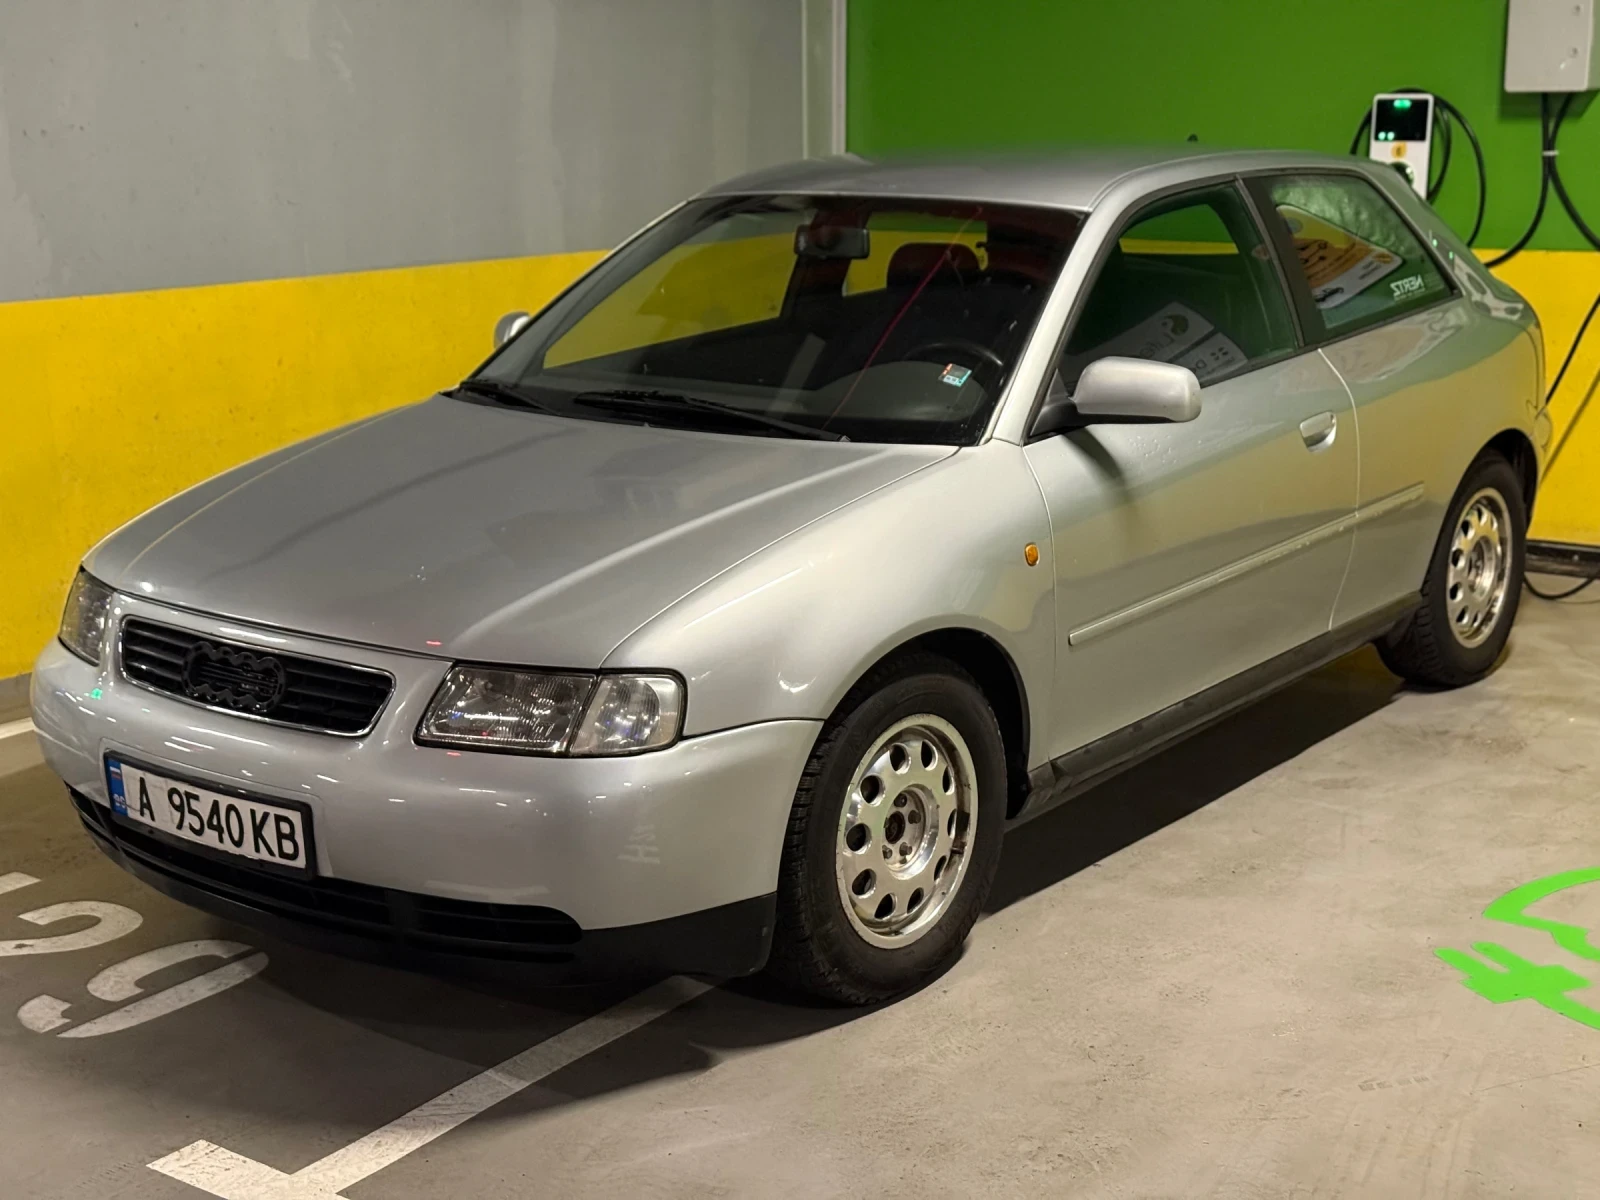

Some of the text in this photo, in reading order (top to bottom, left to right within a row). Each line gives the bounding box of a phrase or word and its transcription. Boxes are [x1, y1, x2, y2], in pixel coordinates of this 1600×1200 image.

[139, 777, 299, 861] A 9540 KB
